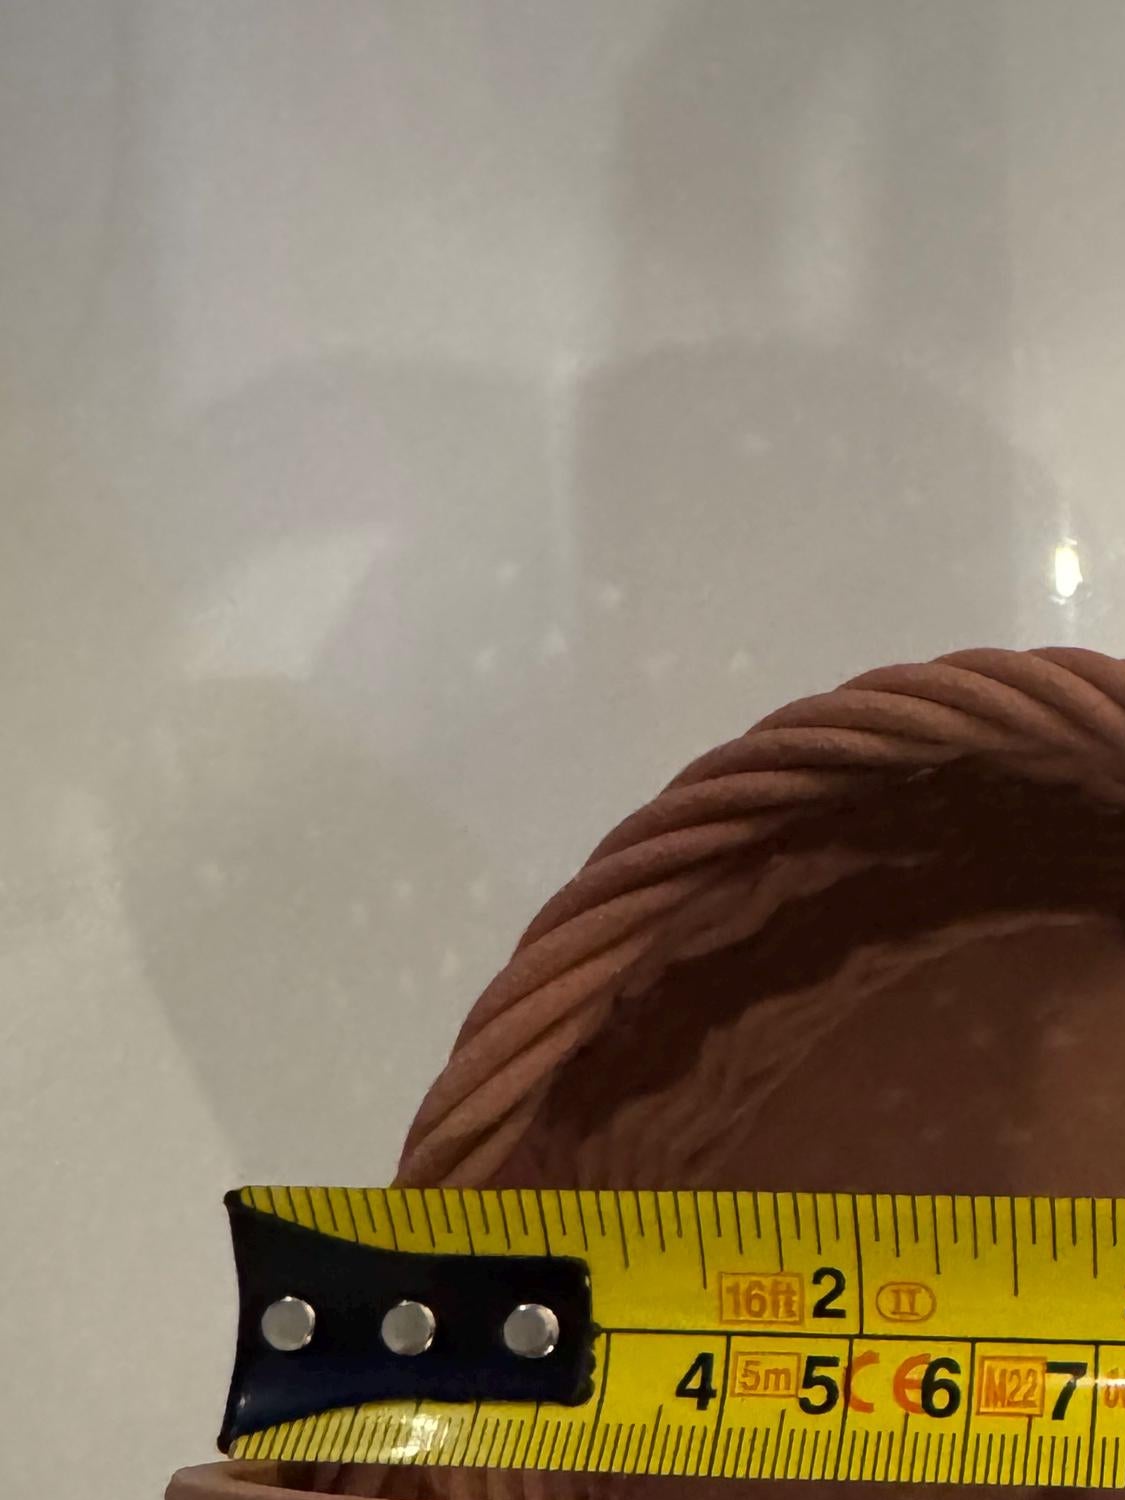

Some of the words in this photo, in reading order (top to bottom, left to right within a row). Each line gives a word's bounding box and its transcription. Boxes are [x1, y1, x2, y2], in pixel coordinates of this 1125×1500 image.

[726, 1279, 797, 1319] 16ft
[812, 1267, 846, 1318] 2
[675, 1352, 717, 1411] 4
[740, 1360, 792, 1392] 5m
[798, 1355, 840, 1415] 5
[921, 1357, 961, 1418] 6
[1045, 1361, 1088, 1421] 7
